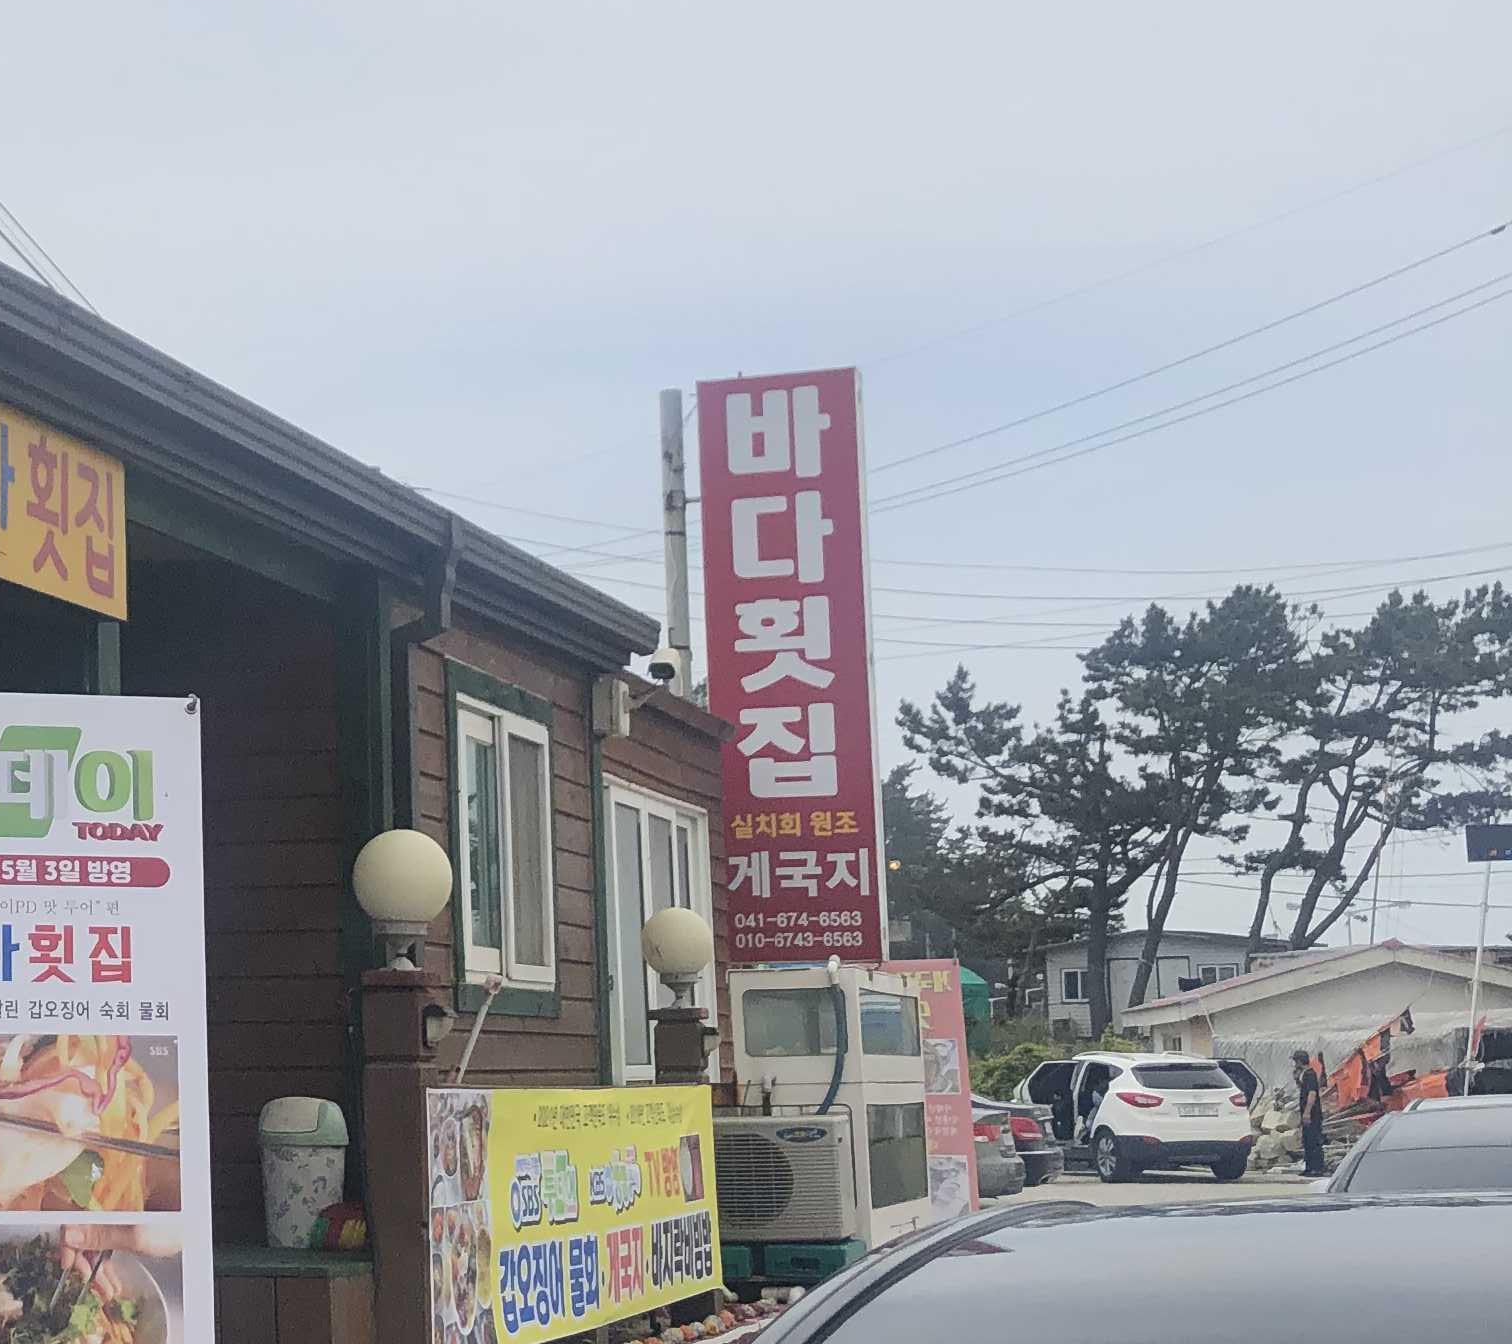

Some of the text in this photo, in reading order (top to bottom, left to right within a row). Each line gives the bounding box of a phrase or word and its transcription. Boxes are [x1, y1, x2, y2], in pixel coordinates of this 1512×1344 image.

[726, 385, 838, 798] 바다횟집
[72, 822, 165, 842] TODAY
[730, 810, 859, 839] 실치회 원조
[1, 858, 37, 882] 5월
[44, 860, 80, 883] 3일
[87, 860, 131, 884] 방영
[727, 847, 870, 898] 게국지
[28, 1000, 90, 1020] 갑오징어
[99, 1001, 130, 1021] 숙회
[138, 1001, 170, 1021] 물회
[499, 1239, 566, 1334] 갑오징어
[569, 1234, 601, 1317] 물회
[606, 1226, 645, 1304] 게국지
